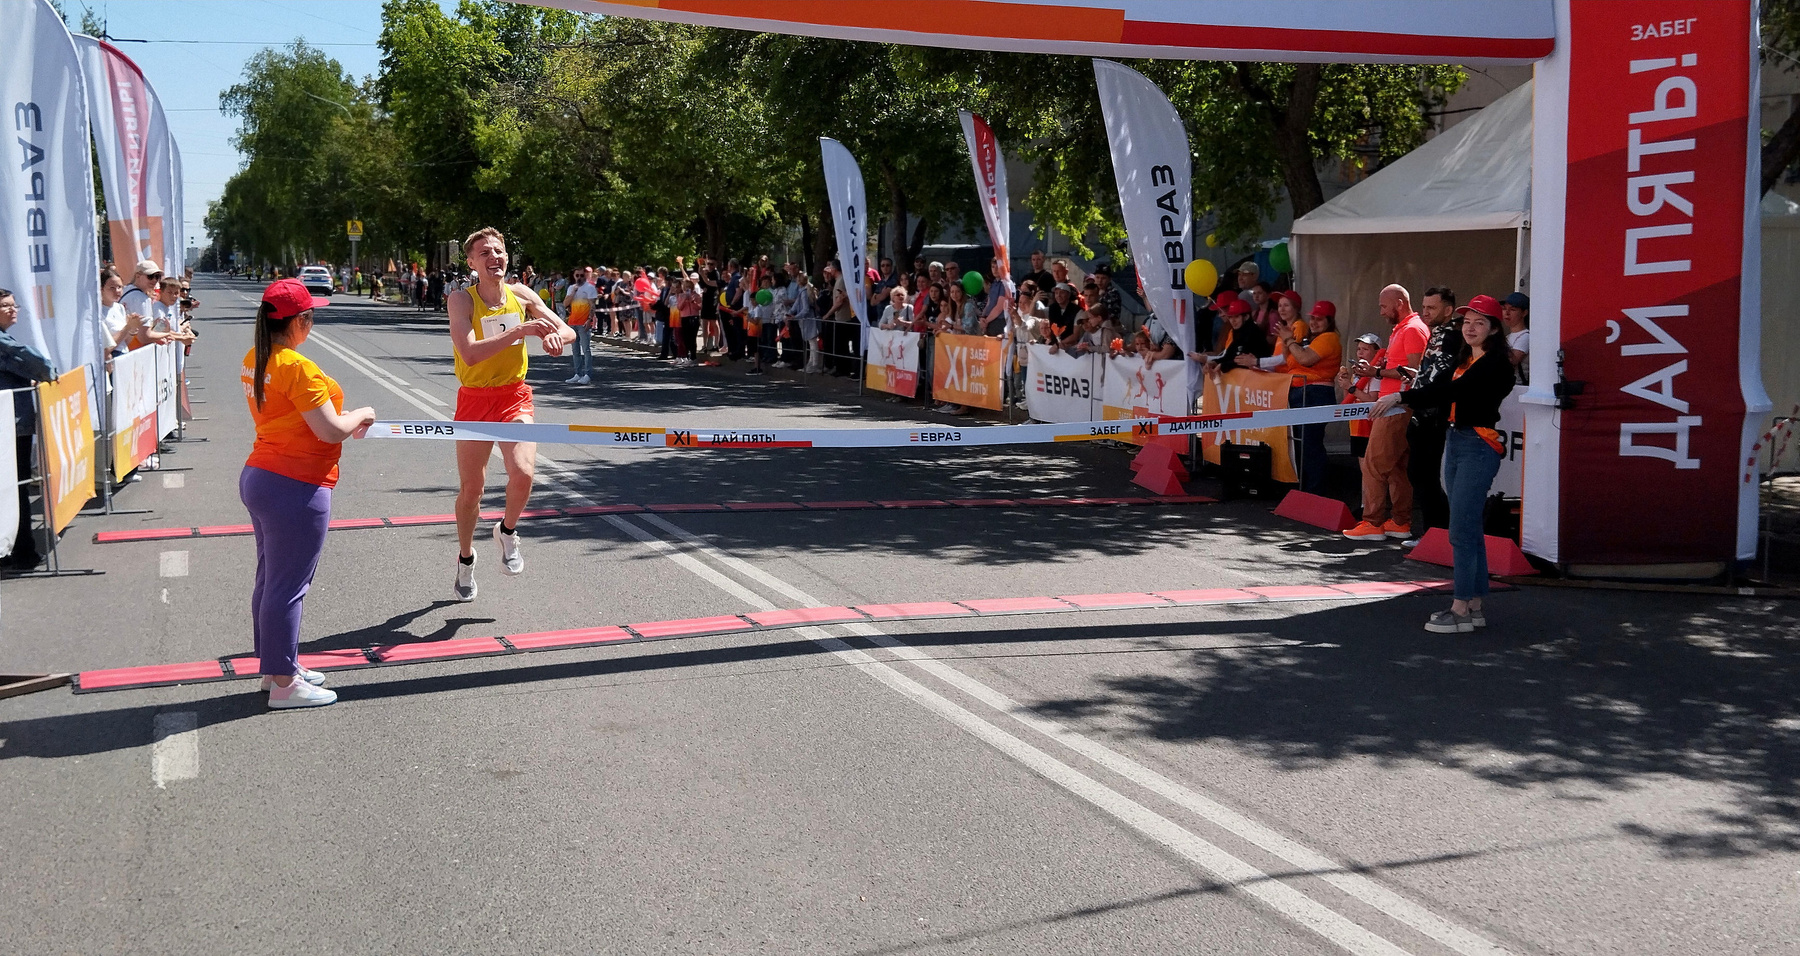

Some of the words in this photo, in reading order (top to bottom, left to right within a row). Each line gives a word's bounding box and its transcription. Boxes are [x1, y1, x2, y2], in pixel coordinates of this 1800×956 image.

[1630, 17, 1698, 41] ЗАБЕГ
[1623, 53, 1698, 276] ПЯТЬ!
[1150, 164, 1186, 290] ЕВРАЗ
[944, 344, 968, 392] XI
[969, 347, 990, 361] ЗАБЕГ
[970, 362, 985, 379] ДАЙ
[1044, 374, 1090, 399] ЕВРАЗ
[1244, 387, 1274, 408] ЗАБЕГ
[1605, 304, 1702, 470] ДАЙ
[403, 425, 454, 435] ЕВРАЗ
[614, 432, 652, 443] ЗАБЕГ
[673, 431, 691, 446] XI
[711, 432, 738, 444] ДАЙ
[741, 433, 776, 444] ПЯТЬ!
[920, 431, 961, 442] ЕВРАЗ
[1090, 426, 1121, 436] ЗАБЕГ
[1139, 421, 1153, 435] XI
[1169, 419, 1192, 432] ДАЙ
[1195, 419, 1223, 430] ПЯТЬ!
[1343, 407, 1370, 417] ЕВРА
